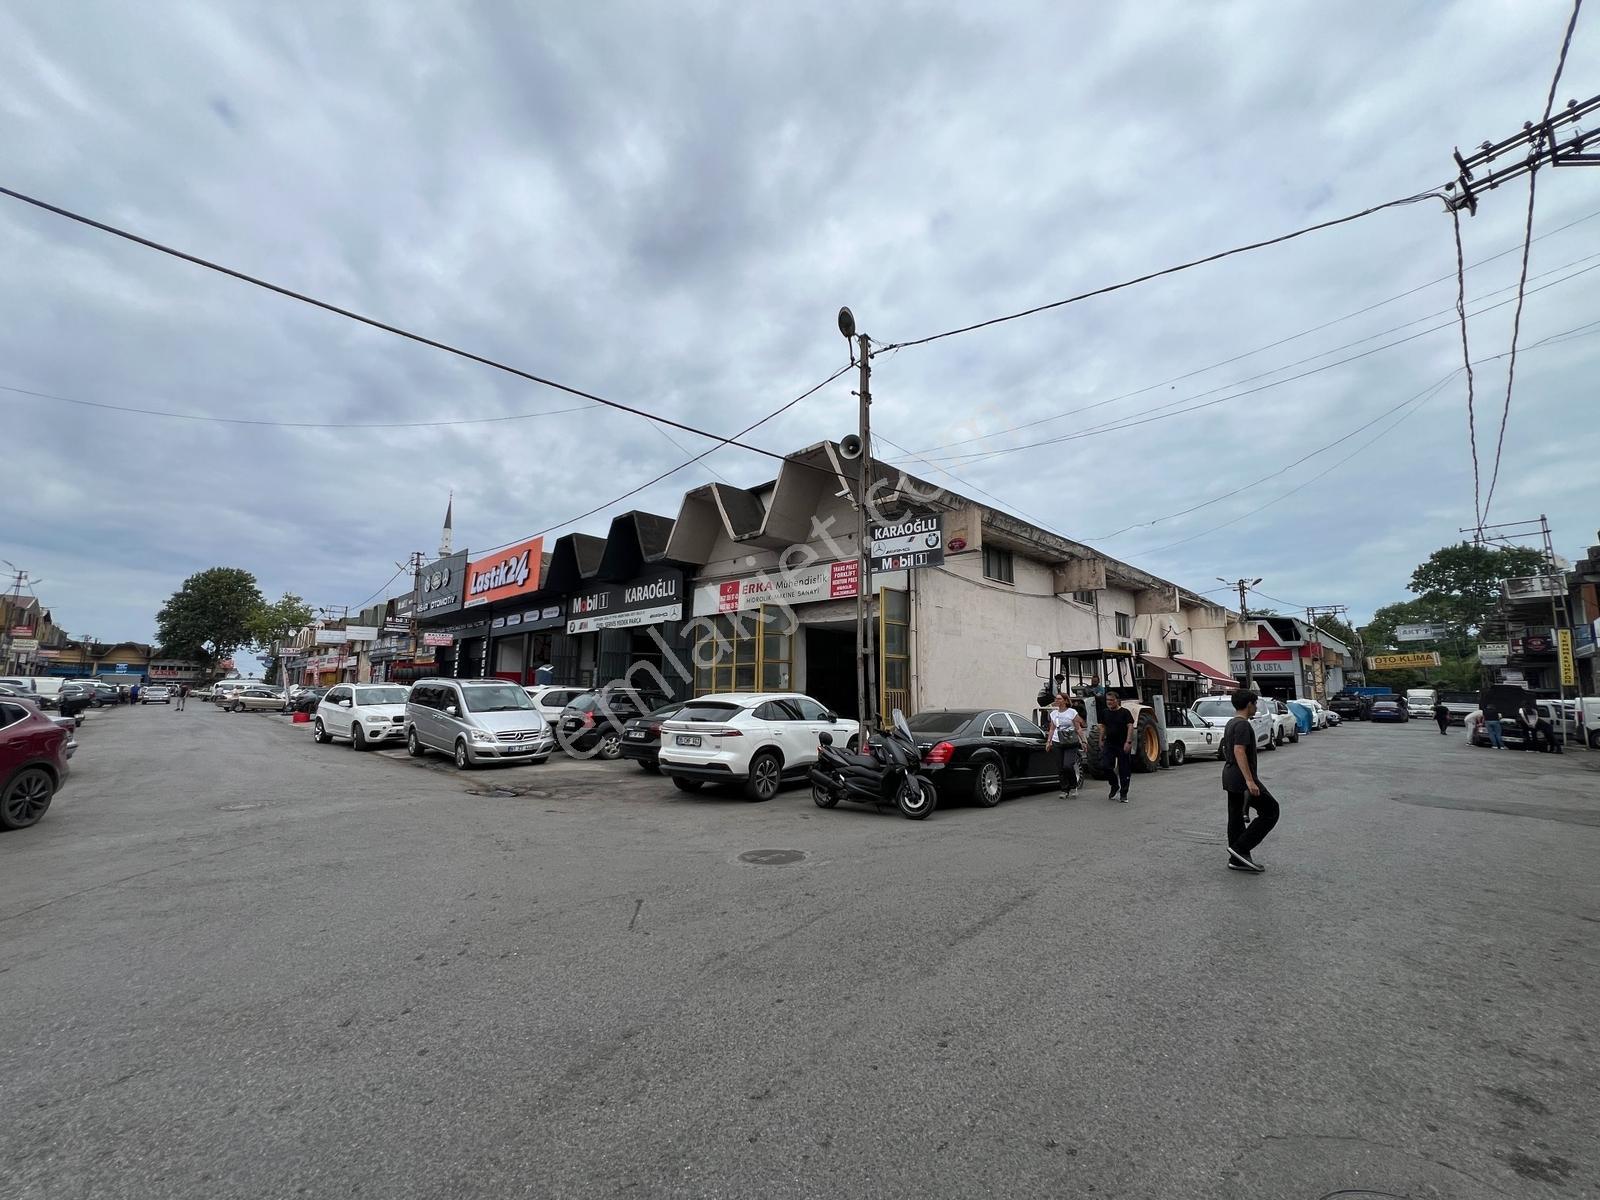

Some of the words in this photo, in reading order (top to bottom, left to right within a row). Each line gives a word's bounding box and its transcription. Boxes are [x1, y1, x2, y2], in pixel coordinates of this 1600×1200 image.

[874, 518, 937, 540] KARAOĞLU
[881, 554, 914, 570] Mobil
[624, 578, 675, 603] KARAOĞLU
[742, 581, 772, 595] ERKA
[572, 593, 598, 614] Mobil
[1263, 662, 1282, 671] USTA
[1375, 655, 1397, 664] OTO
